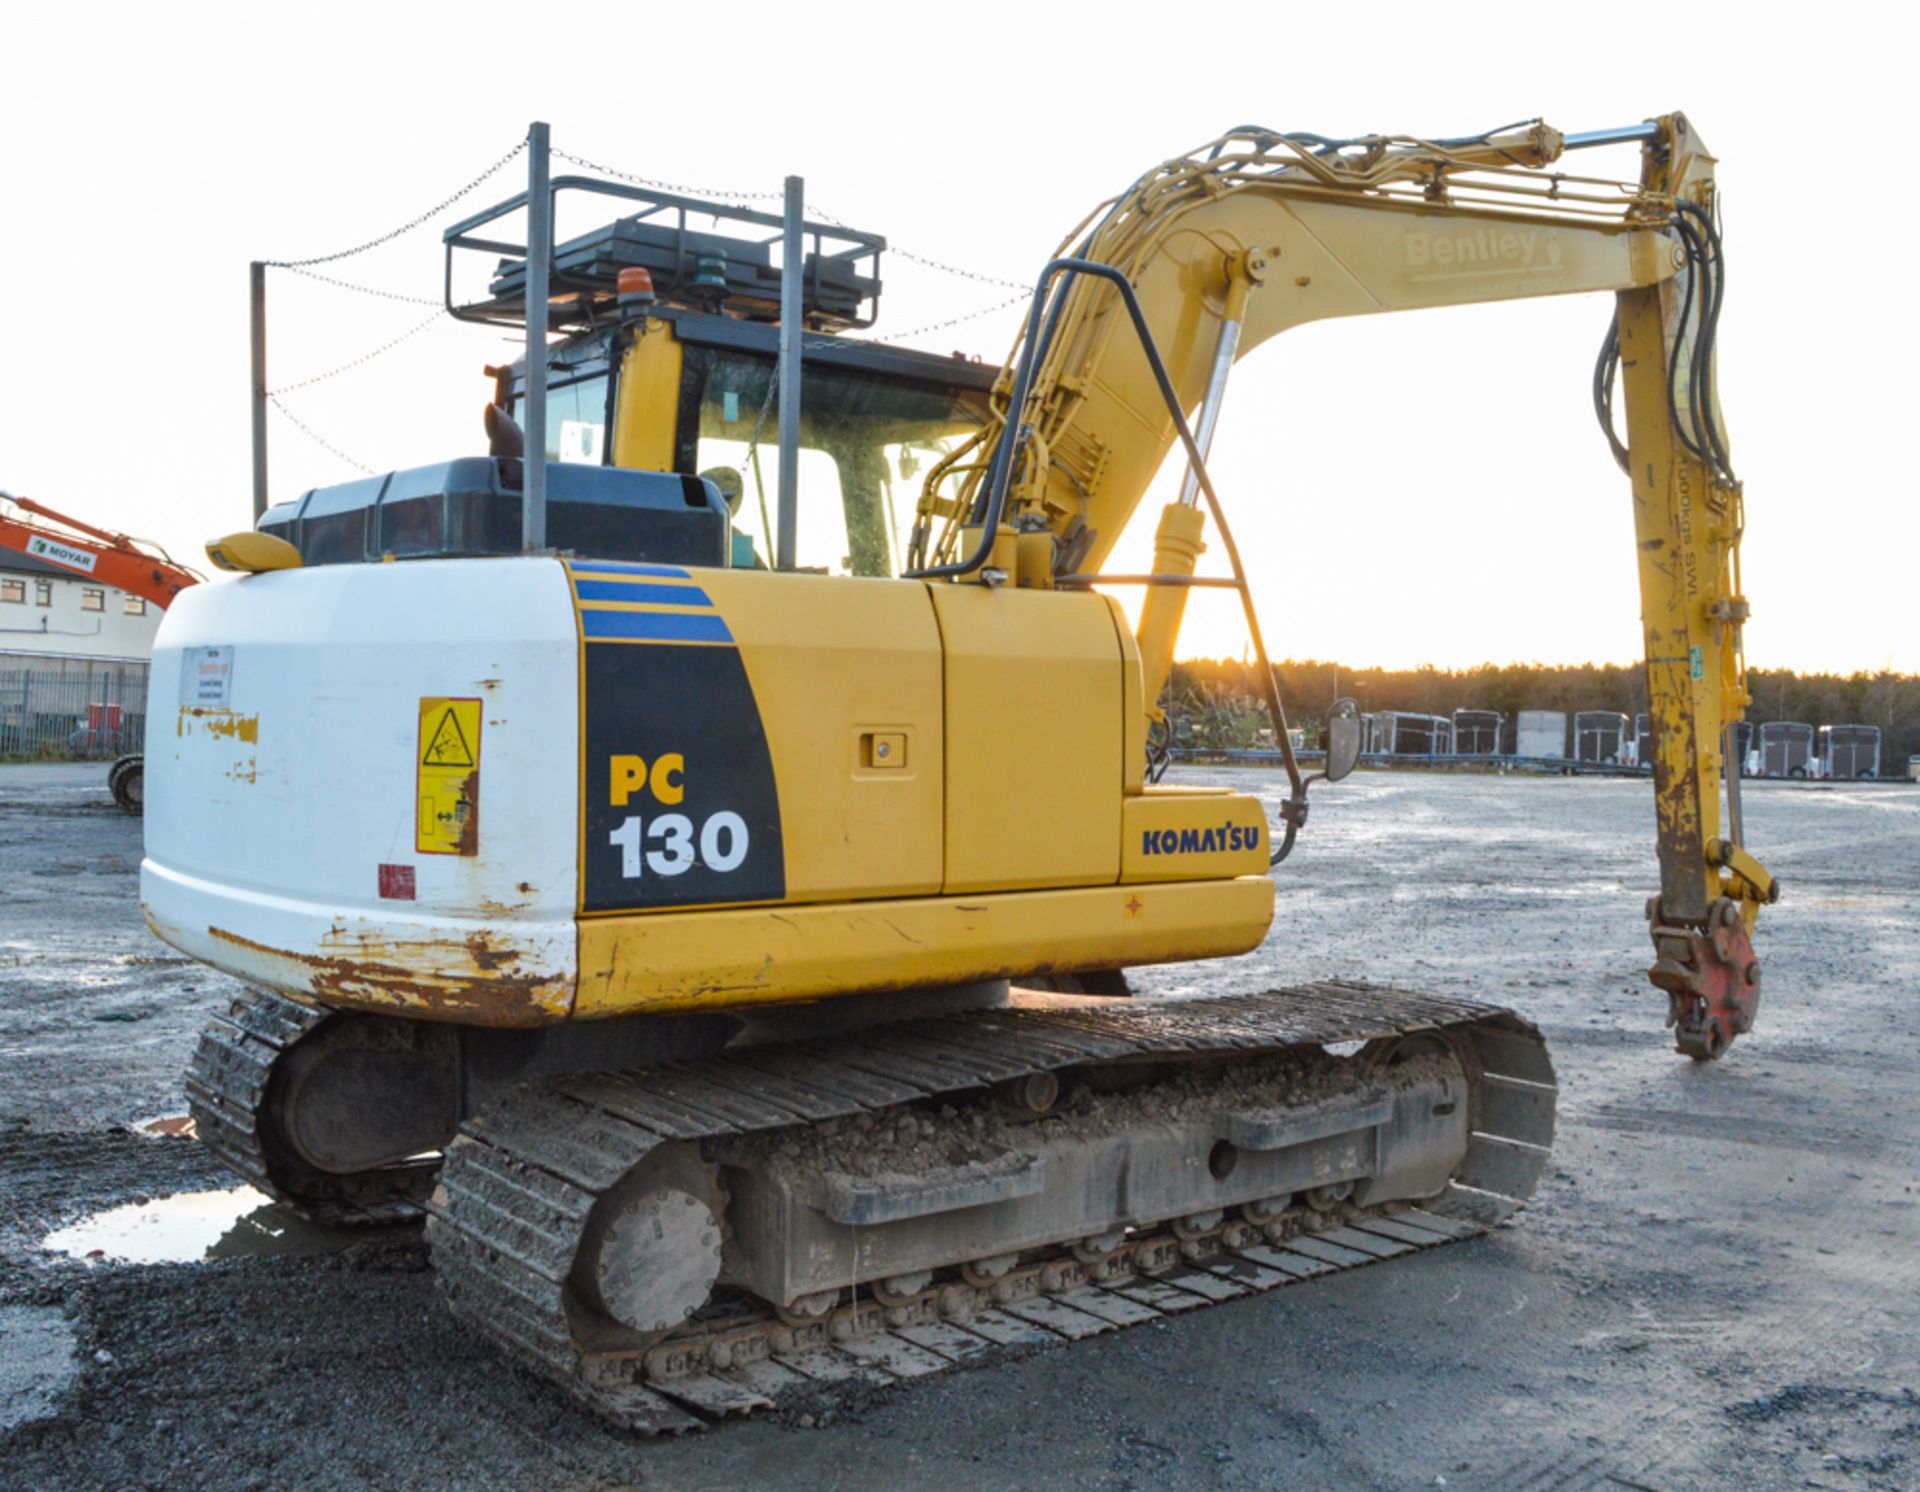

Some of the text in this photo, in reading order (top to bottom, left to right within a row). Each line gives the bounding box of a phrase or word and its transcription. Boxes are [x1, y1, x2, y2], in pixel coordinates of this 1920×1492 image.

[1405, 228, 1536, 266] Bentley
[49, 546, 91, 566] MOYAR
[1685, 552, 1698, 596] SWL
[610, 752, 684, 806] PC
[609, 810, 749, 878] 130
[1143, 821, 1259, 855] KOMATSU
